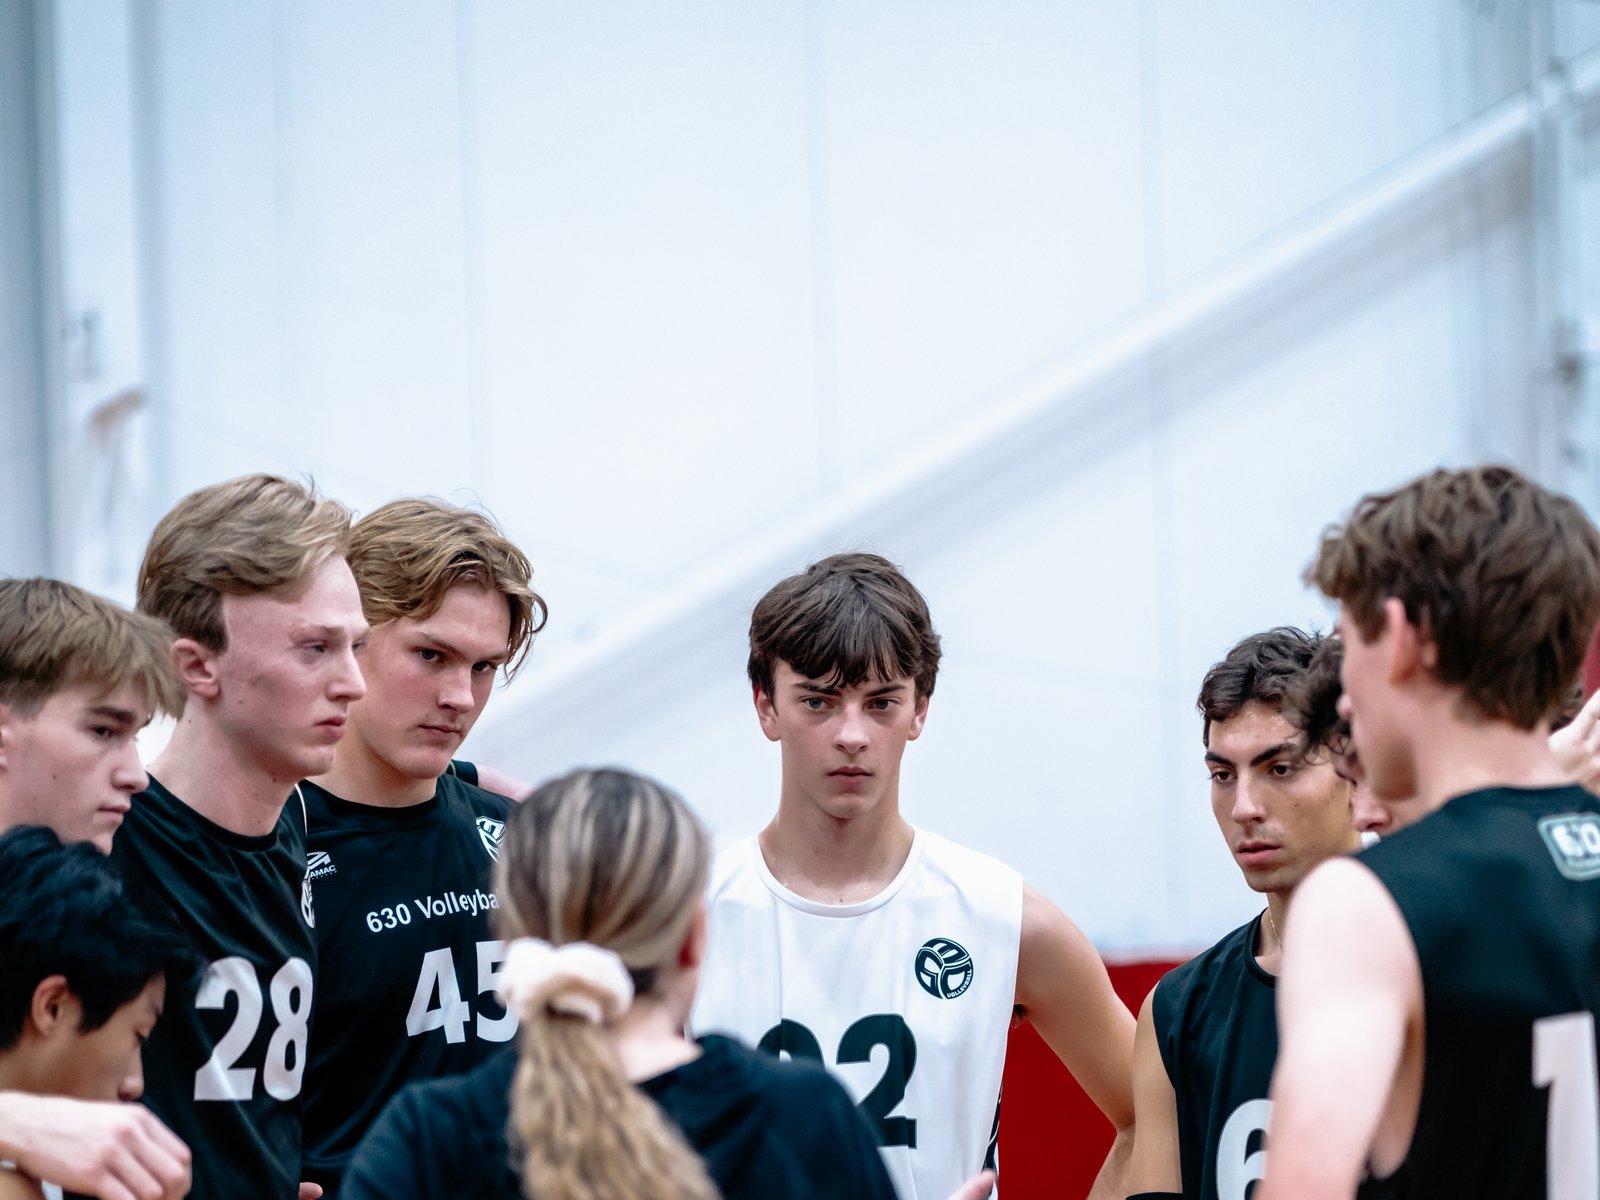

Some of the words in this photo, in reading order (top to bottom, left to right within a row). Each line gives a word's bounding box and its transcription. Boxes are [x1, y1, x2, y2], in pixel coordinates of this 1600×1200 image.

[366, 903, 411, 933] 630
[414, 888, 502, 917] Volleyba
[193, 956, 314, 1101] 28
[405, 939, 520, 1044] 45
